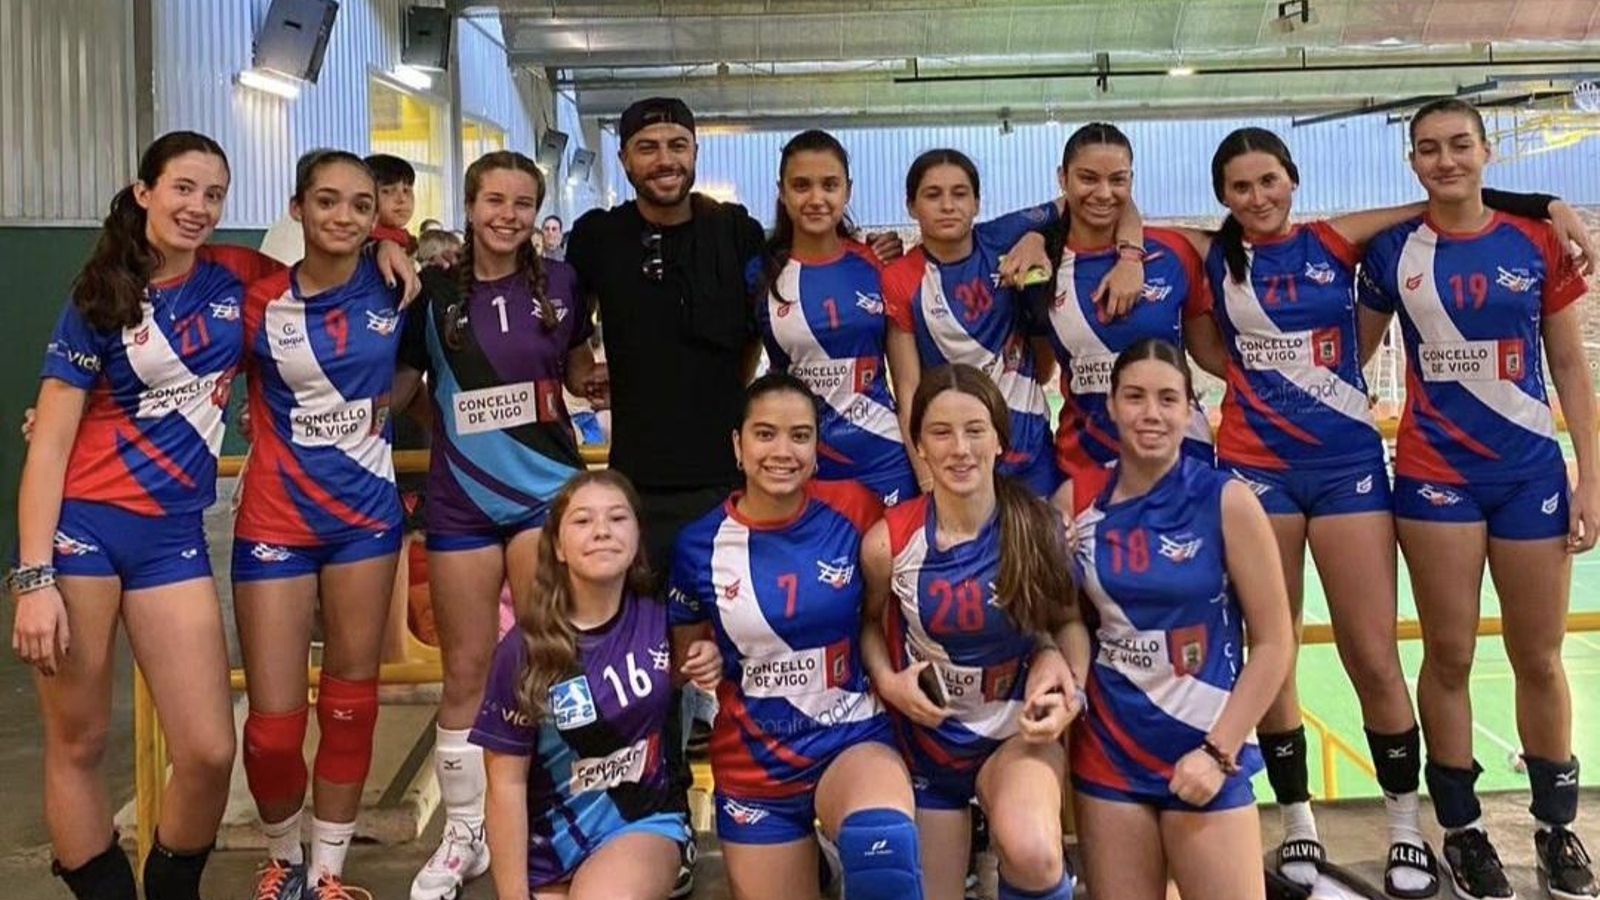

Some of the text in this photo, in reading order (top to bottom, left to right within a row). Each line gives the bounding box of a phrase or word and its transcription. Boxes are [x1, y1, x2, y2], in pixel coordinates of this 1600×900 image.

[1263, 273, 1298, 307] 21
[1449, 272, 1488, 310] 19
[491, 296, 509, 332] 1
[823, 297, 842, 329] 1
[174, 312, 212, 357] 21
[323, 308, 350, 358] 9
[1240, 338, 1303, 351] CONCELLO
[1423, 349, 1488, 361] CONCELLO
[1247, 351, 1297, 363] DE VIGO
[1432, 362, 1480, 373] DE VIGO
[814, 377, 840, 388] VIGO
[1079, 376, 1094, 386] DE
[459, 391, 528, 412] CONCELLO
[295, 408, 366, 425] CONCELLO
[469, 406, 521, 424] DE VIGO
[305, 423, 358, 438] DE VIGO
[1106, 528, 1150, 575] 18
[777, 573, 798, 618] 7
[928, 577, 985, 634] 28
[746, 658, 815, 676] CONCELLO
[603, 652, 652, 708] 16
[755, 673, 808, 687] DE VIGO
[1282, 845, 1428, 867] CALVIN KLEIN
